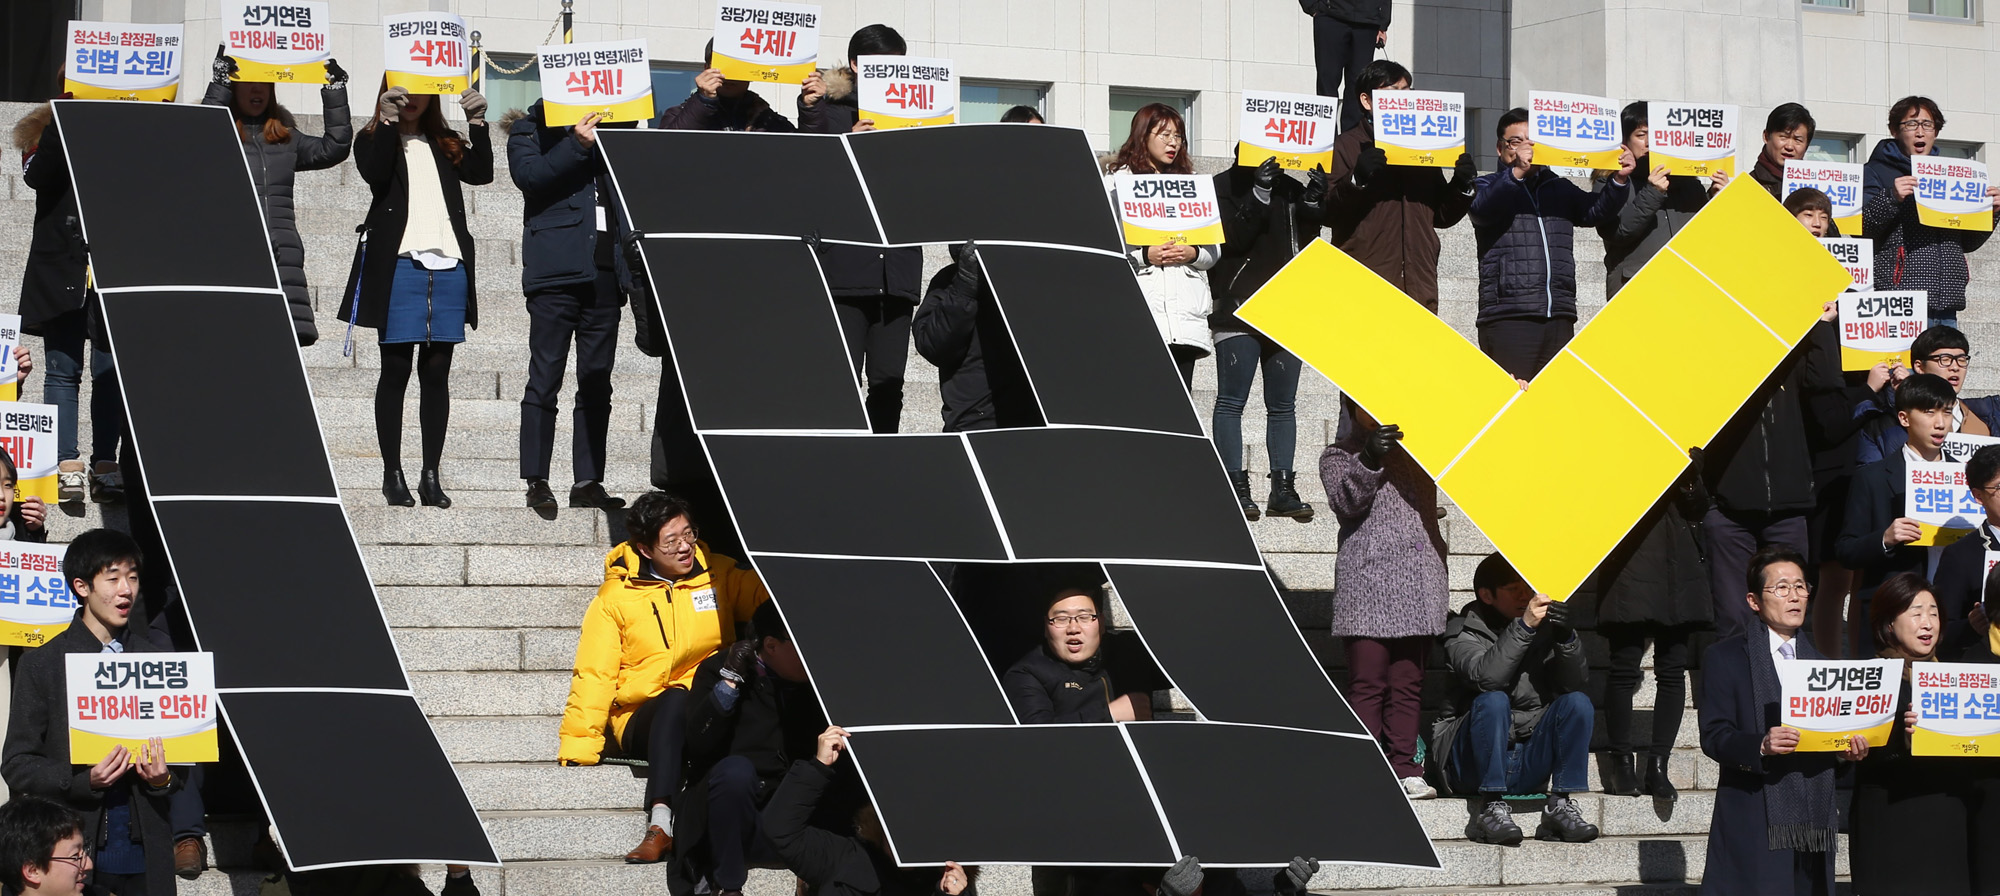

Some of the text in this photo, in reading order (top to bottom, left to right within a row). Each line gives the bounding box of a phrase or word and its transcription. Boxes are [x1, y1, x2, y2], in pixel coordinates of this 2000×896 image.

[243, 5, 312, 27] 선거연령
[721, 6, 816, 28] 정당가입 연령제한
[74, 30, 179, 47] 청소년의 참정권을 위한
[389, 21, 437, 38] 정당가입
[230, 30, 324, 51] 만18세로 인하!
[740, 28, 796, 57] 삭제!
[76, 48, 173, 75] 헌법 소원!
[410, 40, 462, 67] 삭제!
[542, 48, 643, 68] 정당가입 연령제한
[566, 69, 622, 96] 삭제!
[863, 64, 949, 81] 정당가입 연령제한
[885, 83, 934, 110] 삭제!
[1378, 97, 1414, 110] 청소년의
[1416, 98, 1448, 112] 참정권을
[1533, 98, 1569, 112] 청소년의
[1571, 102, 1604, 116] 선거권을
[1246, 98, 1333, 119] 정당가입 연령제한
[1666, 108, 1723, 128] 선거연령
[1265, 118, 1316, 145] 삭제!
[1381, 113, 1457, 137] 헌법 소원!
[1537, 114, 1614, 141] 헌법 소원!
[1655, 130, 1731, 149] 만18세로 인하!
[1787, 167, 1816, 179] 청소년의
[1916, 162, 1946, 176] 청소년의
[1133, 180, 1197, 198] 선거연령
[1919, 177, 1986, 203] 헌법 소원!
[1124, 201, 1212, 218] 만18세로 인하!
[1856, 297, 1913, 318] 선거연령
[1, 328, 16, 340] 위한
[1845, 321, 1897, 340] 만18세로
[6, 413, 53, 433] 연령제한
[1912, 470, 1952, 485] 청소년의
[1914, 488, 1953, 513] 헌법
[94, 661, 188, 689] 선거연령
[1807, 667, 1883, 691] 선거연령
[1918, 672, 1998, 688] 청소년의 참정권을
[77, 694, 207, 720] 만18세로 인하!
[1790, 694, 1893, 718] 만18세로 인하!
[1921, 691, 1958, 719] 헌법
